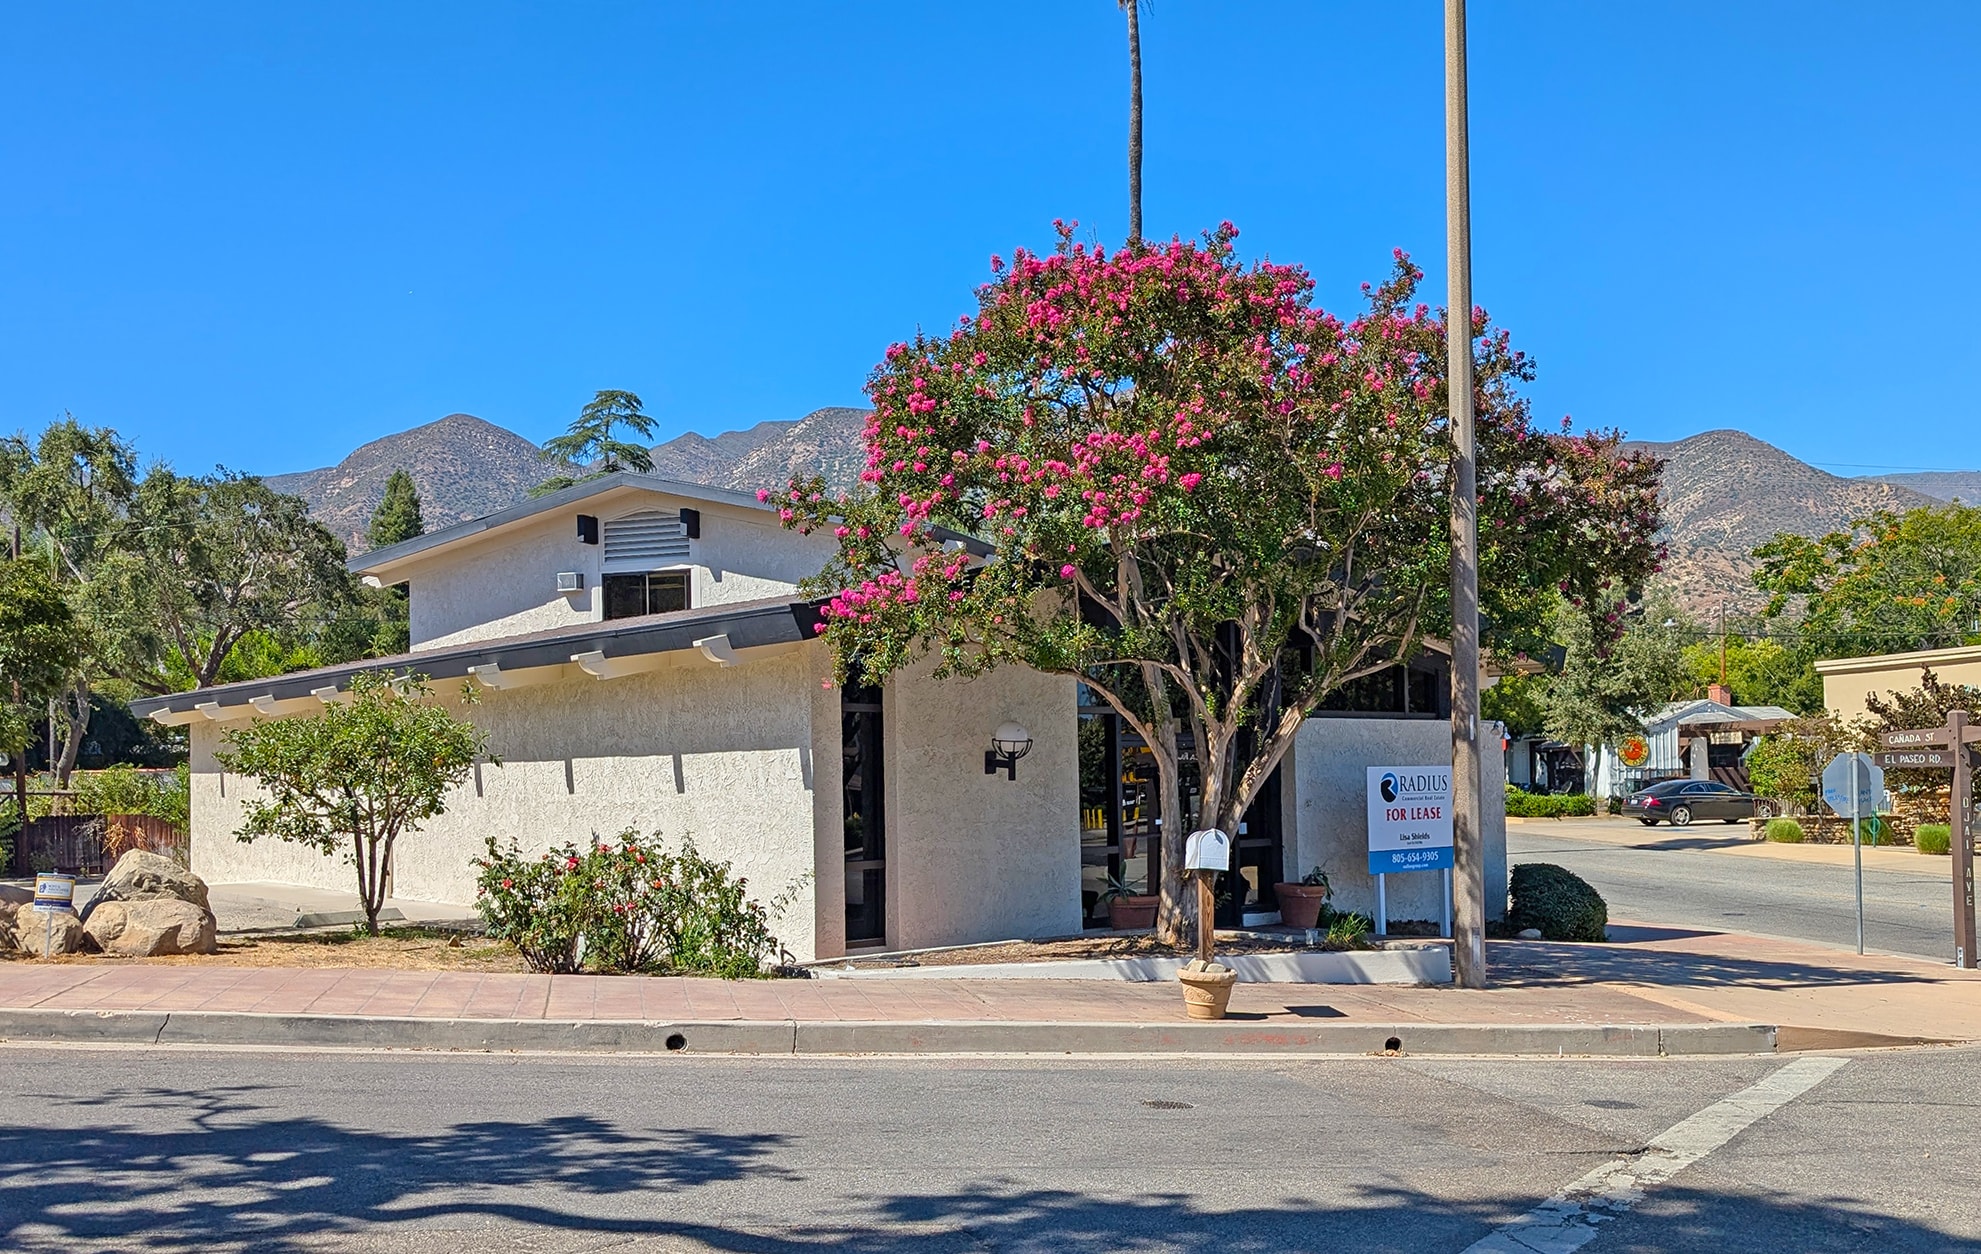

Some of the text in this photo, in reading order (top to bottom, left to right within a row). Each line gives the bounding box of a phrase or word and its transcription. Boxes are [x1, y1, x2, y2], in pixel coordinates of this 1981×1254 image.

[1888, 732, 1937, 745] CAÑADA ST.
[1885, 754, 1943, 764] EL PASEO RD.
[1400, 775, 1448, 792] RADIUS
[1386, 807, 1441, 821] FOR LEASE
[1400, 832, 1430, 841] Lisa Shields
[1391, 851, 1439, 863] 805-654-9305
[1962, 796, 1973, 906] OJAI AVE
